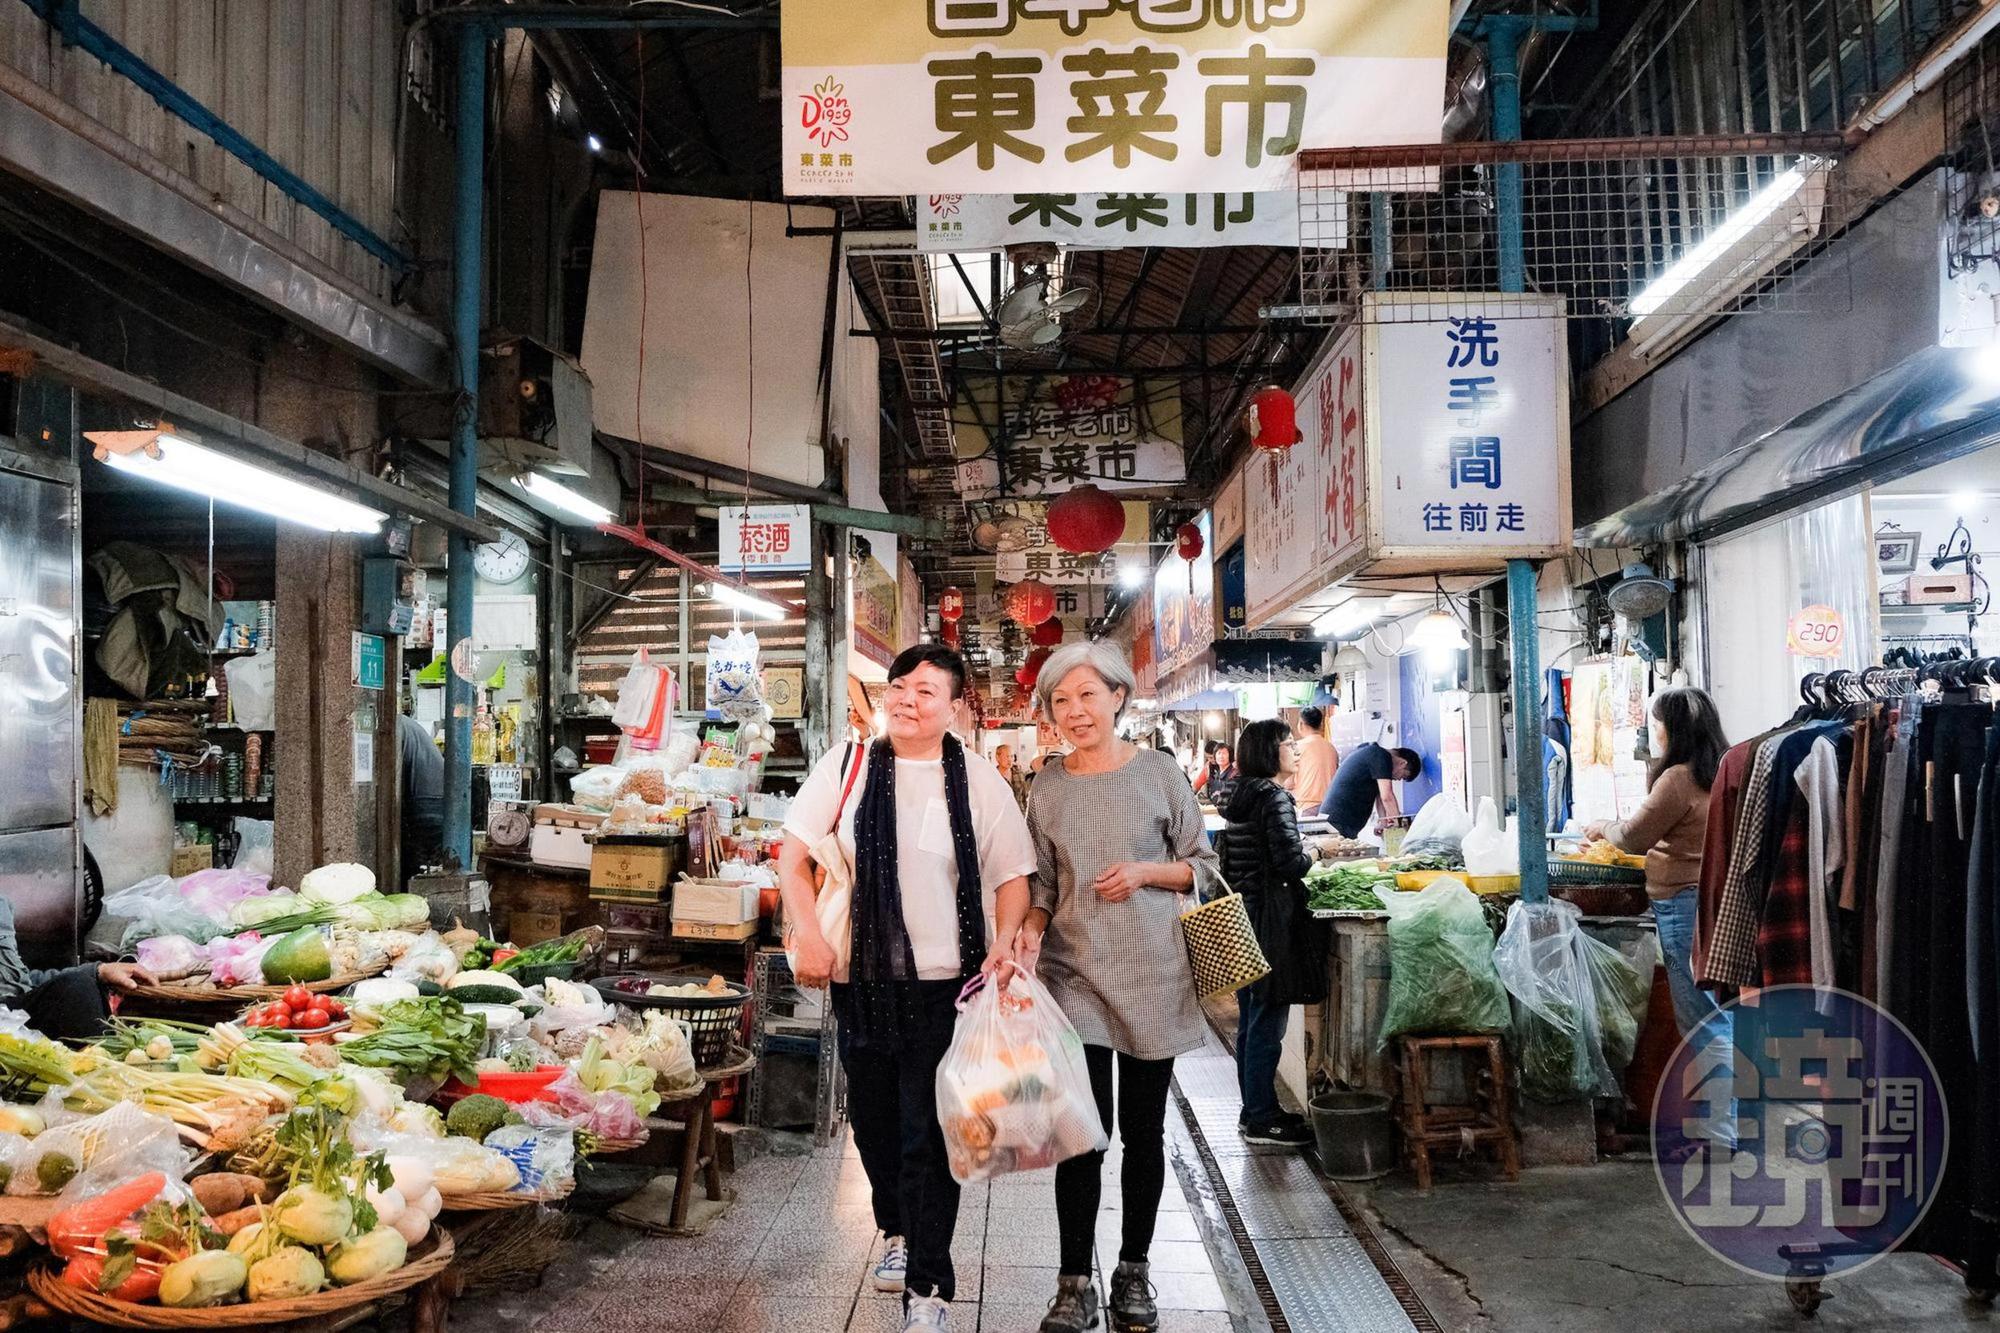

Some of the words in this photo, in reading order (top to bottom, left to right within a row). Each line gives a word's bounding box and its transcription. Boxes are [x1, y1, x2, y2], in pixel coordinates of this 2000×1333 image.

[926, 43, 1316, 171] 東菜市
[800, 153, 853, 167] 東菜市
[1446, 315, 1501, 490] 洗手間
[1006, 440, 1137, 493] 東菜市
[1422, 502, 1525, 532] 往前走
[739, 523, 790, 553] 菸酒
[1799, 622, 1840, 642] 290
